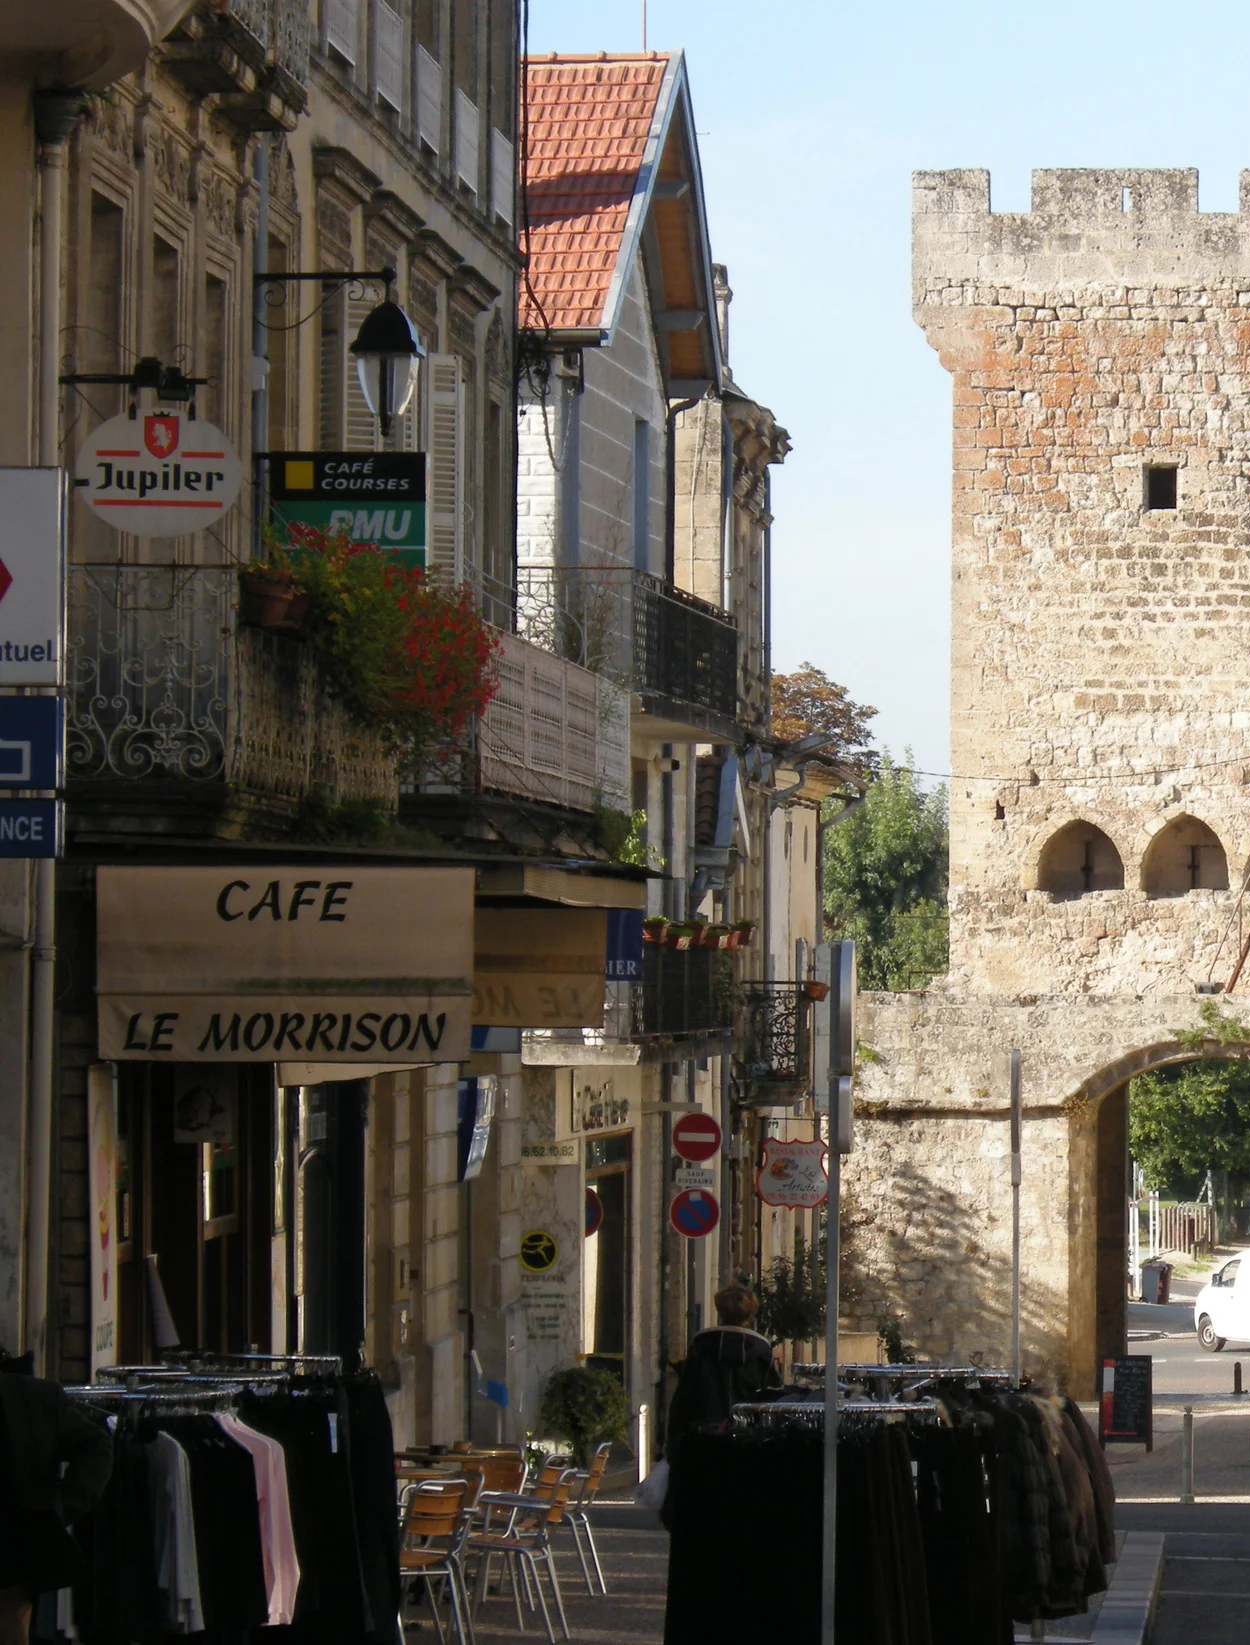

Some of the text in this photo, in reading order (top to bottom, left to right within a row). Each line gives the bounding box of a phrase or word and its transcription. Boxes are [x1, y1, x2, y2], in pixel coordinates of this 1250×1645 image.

[324, 458, 374, 474] CAFÉ
[96, 462, 224, 498] Jupiler
[321, 478, 410, 490] COURSES
[327, 510, 413, 540] PMU
[0, 640, 52, 662] tuel
[216, 880, 354, 923] CAFE
[606, 960, 637, 975] IER
[123, 1012, 447, 1051] LE MORRISON
[770, 1147, 820, 1156] RESTAURANT
